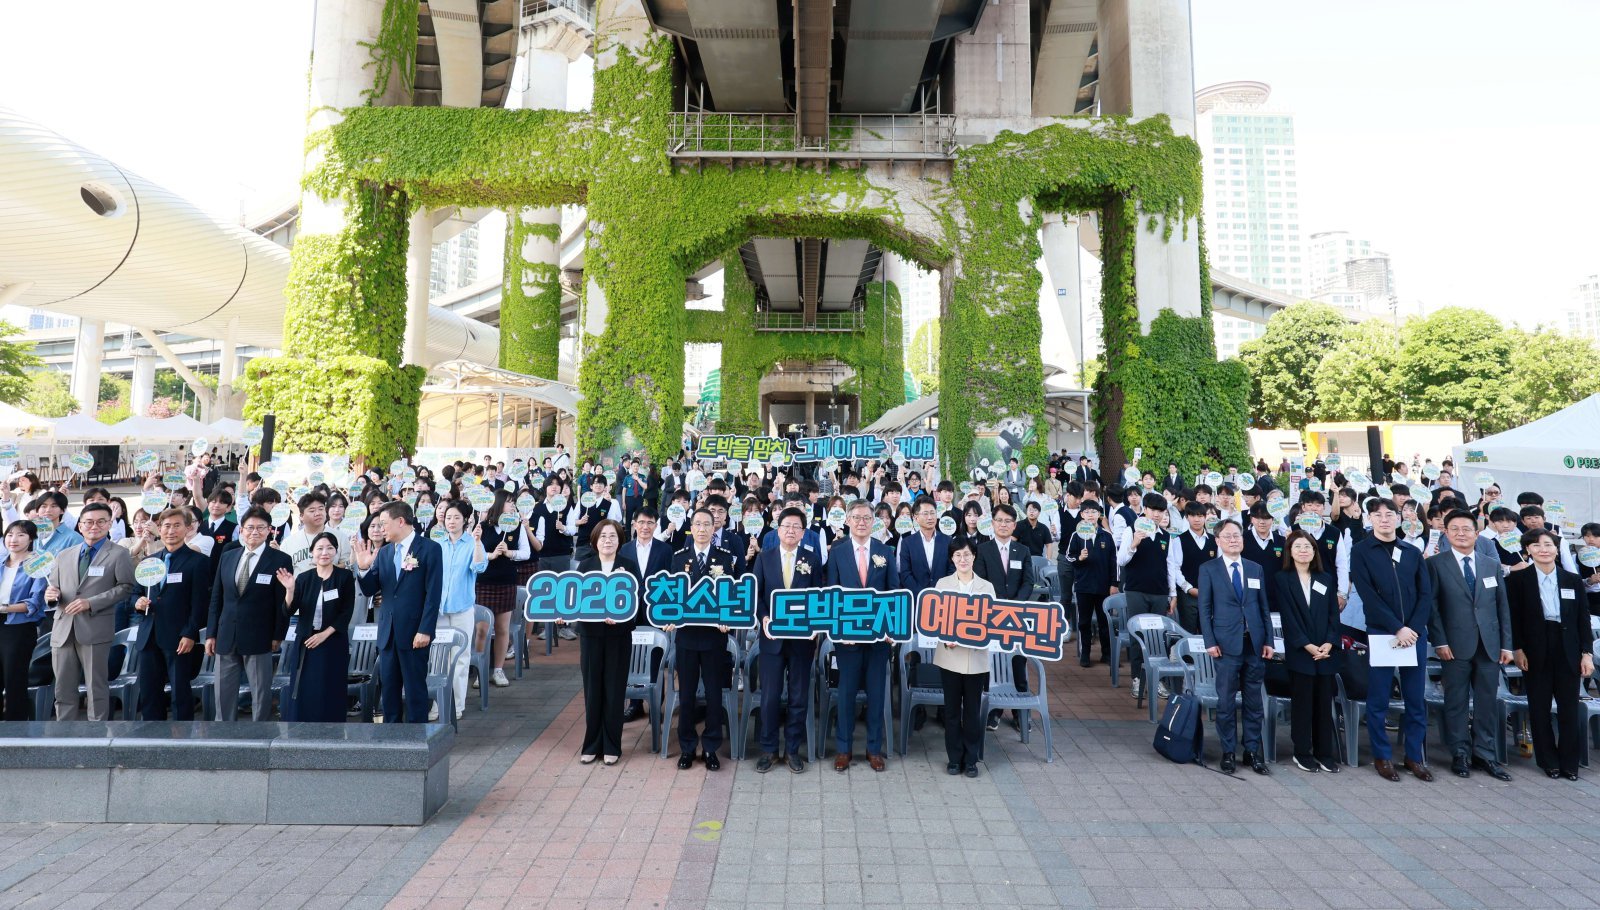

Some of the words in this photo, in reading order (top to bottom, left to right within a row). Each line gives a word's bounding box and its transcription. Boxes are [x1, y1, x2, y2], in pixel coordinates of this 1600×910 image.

[700, 437, 751, 459] 도박을
[796, 438, 832, 460] 그게
[834, 435, 885, 458] 이기는
[894, 437, 934, 458] 거야!
[1577, 457, 1600, 469] PRE
[530, 576, 632, 614] 2026
[649, 576, 751, 621] 청소년
[771, 591, 908, 635] 도박문제
[920, 593, 1062, 653] 예방주간
